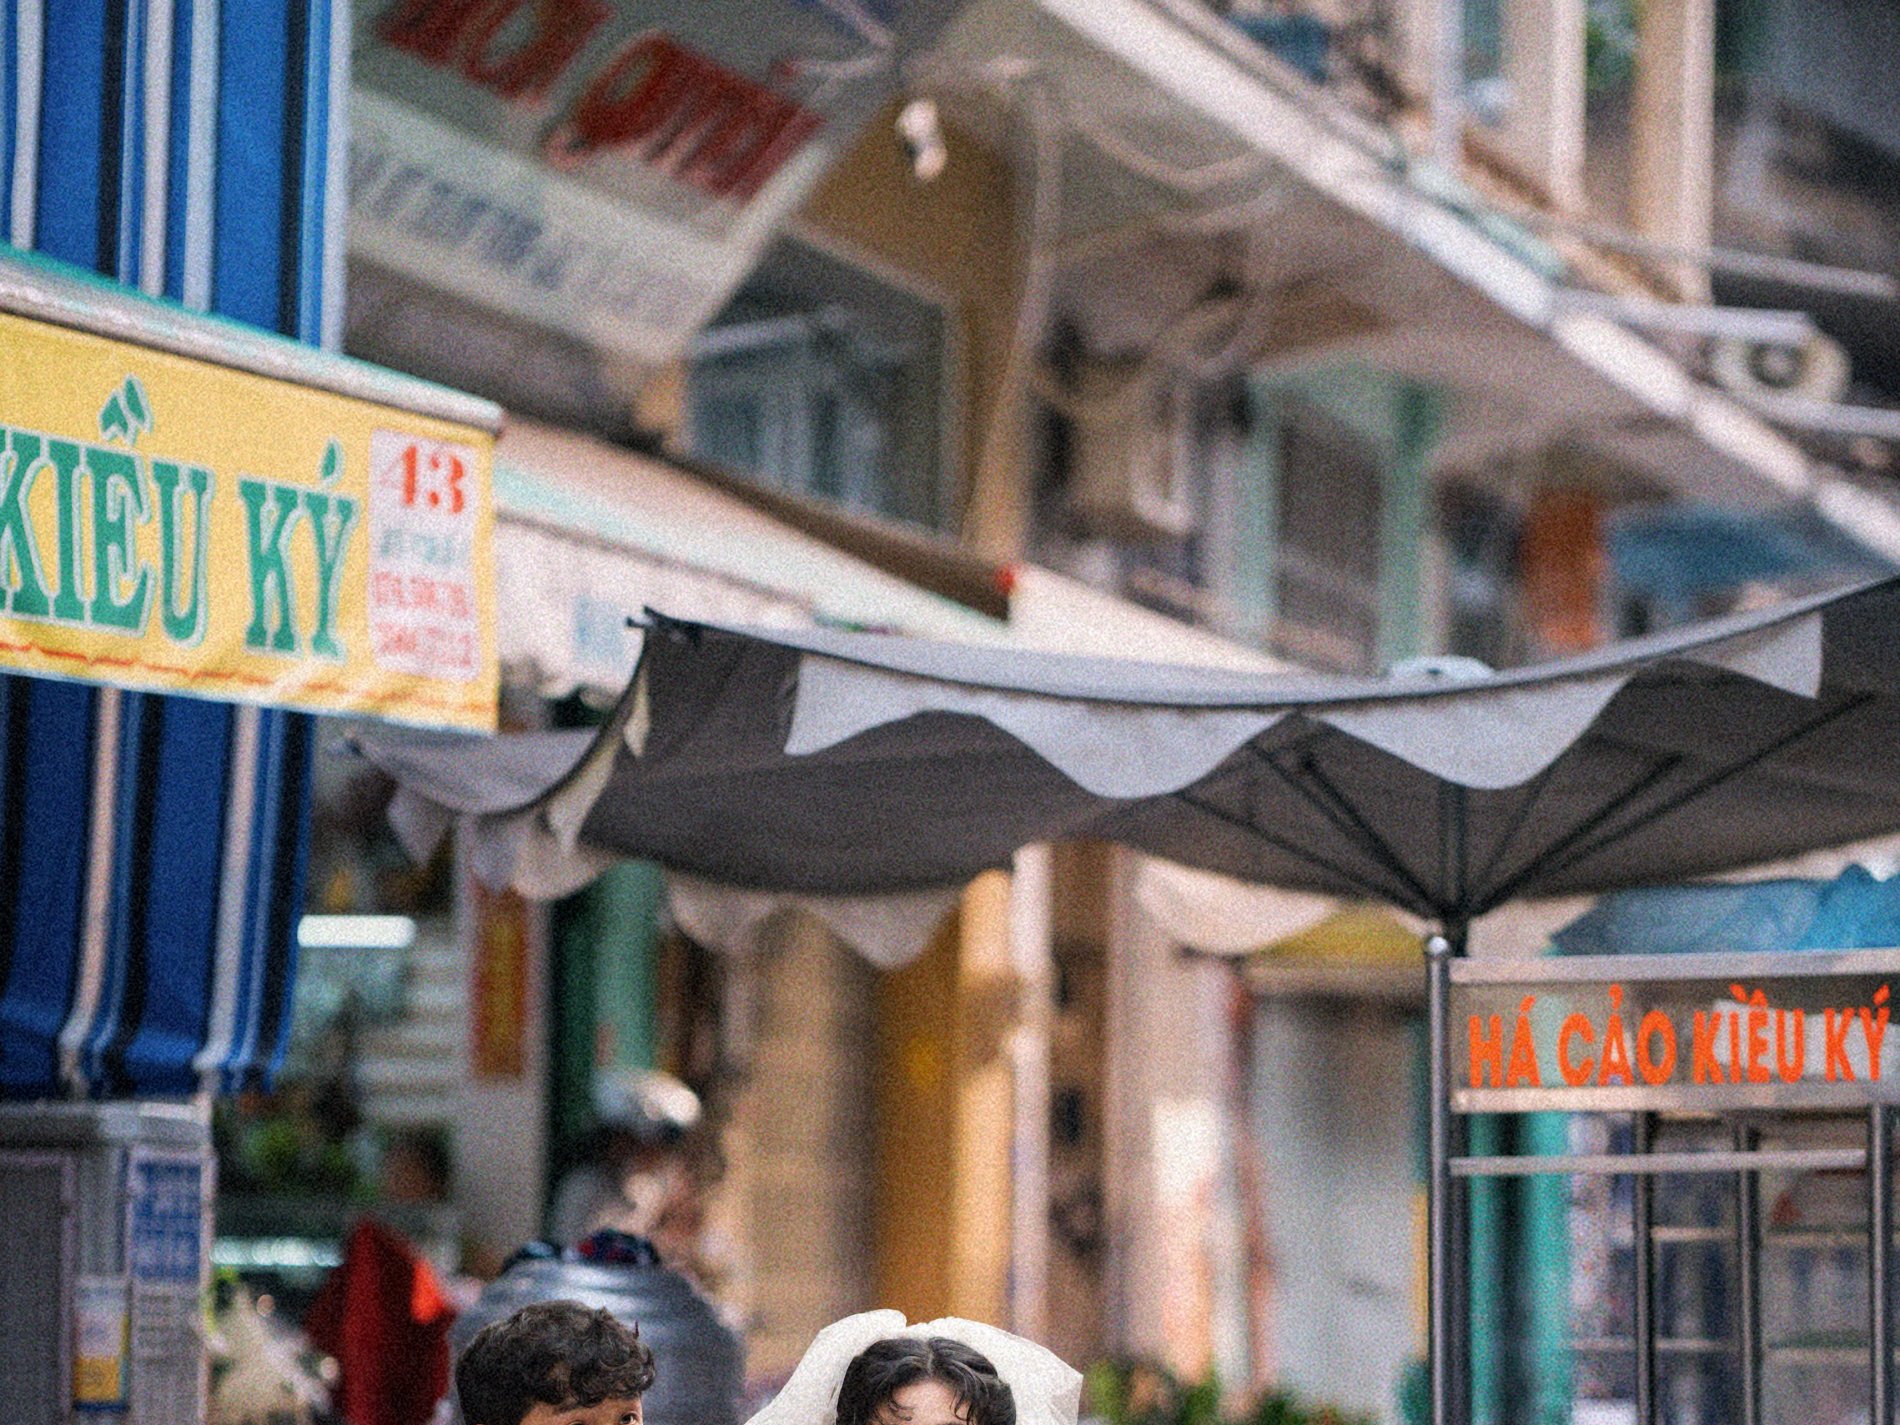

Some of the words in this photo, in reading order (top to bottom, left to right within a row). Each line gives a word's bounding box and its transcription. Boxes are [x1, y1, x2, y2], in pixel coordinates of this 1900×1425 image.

[239, 439, 359, 660] KÝ
[1468, 996, 1541, 1088] HÁ
[1557, 983, 1677, 1087] CẢO
[1693, 984, 1805, 1084] KIỀU
[1824, 984, 1890, 1083] KÝ
